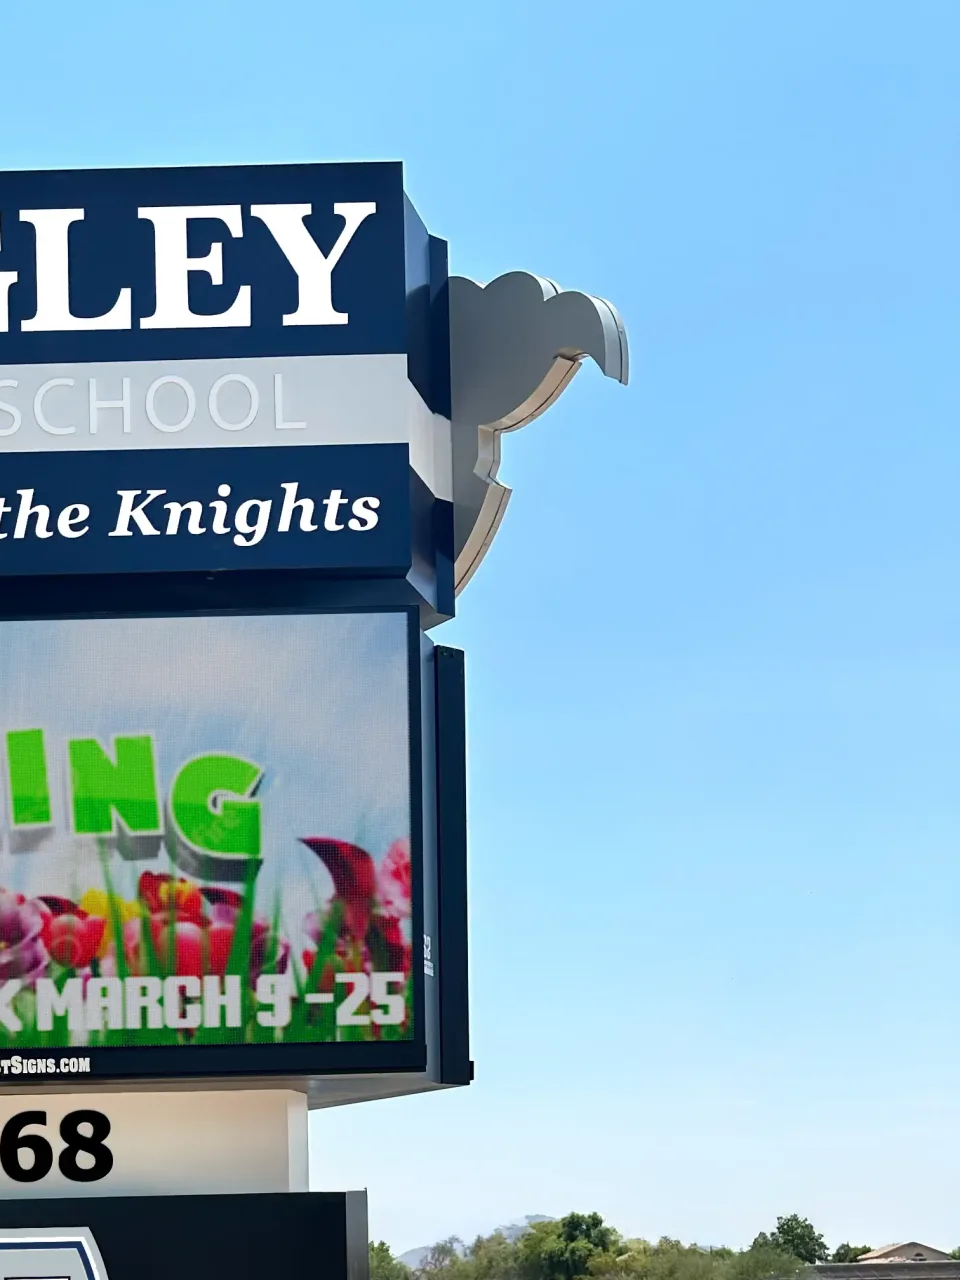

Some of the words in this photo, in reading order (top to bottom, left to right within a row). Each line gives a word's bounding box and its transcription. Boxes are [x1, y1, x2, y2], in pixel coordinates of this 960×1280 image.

[109, 482, 380, 547] Knights
[36, 974, 242, 1032] MARCH
[254, 973, 292, 1028] 9
